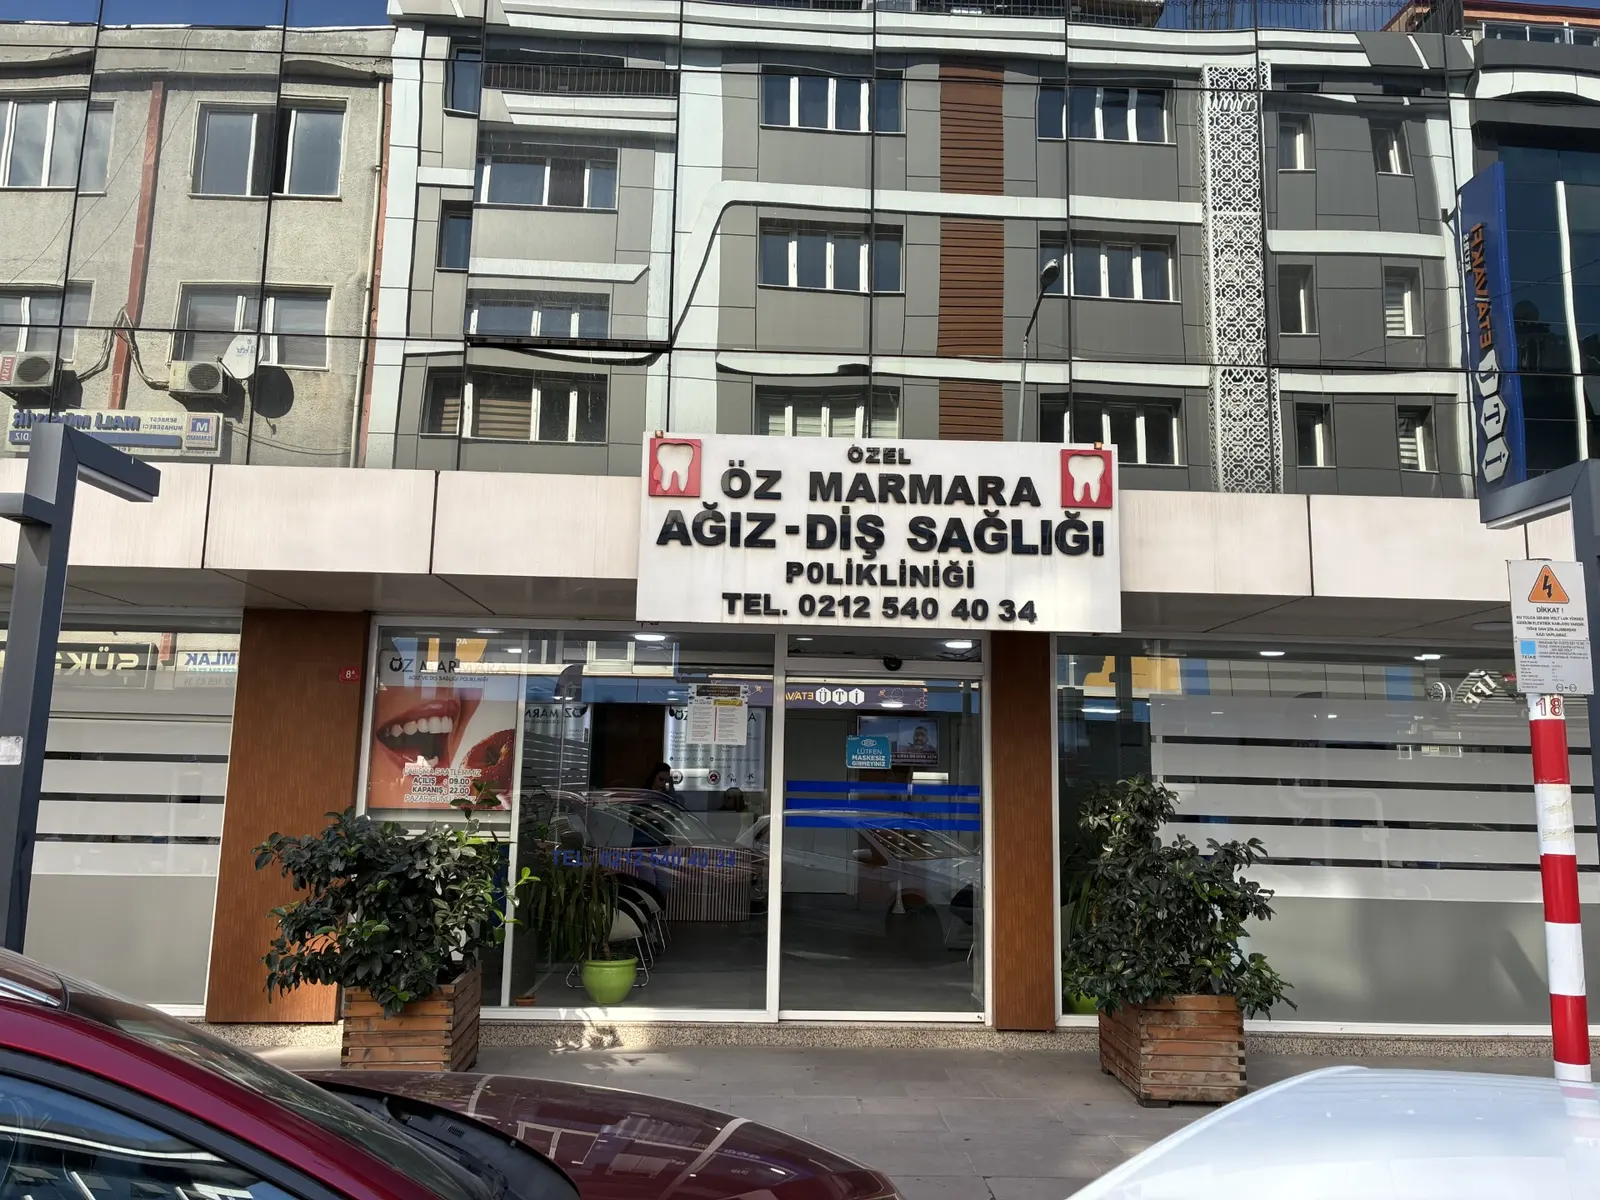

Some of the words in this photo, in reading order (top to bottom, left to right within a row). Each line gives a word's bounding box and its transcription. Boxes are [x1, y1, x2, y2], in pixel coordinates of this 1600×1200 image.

[847, 444, 911, 464] ÖZEL
[720, 460, 782, 499] ÖZ
[809, 471, 1041, 507] MARMARA
[907, 509, 1105, 556] SAĞLIĞI
[785, 557, 975, 588] POLİKLİNİĞİ
[722, 592, 787, 617] TEL.
[798, 594, 870, 619] 0212
[881, 596, 939, 620] 540
[951, 598, 989, 621] 40
[998, 600, 1037, 623] 34
[1535, 697, 1562, 716] 18
